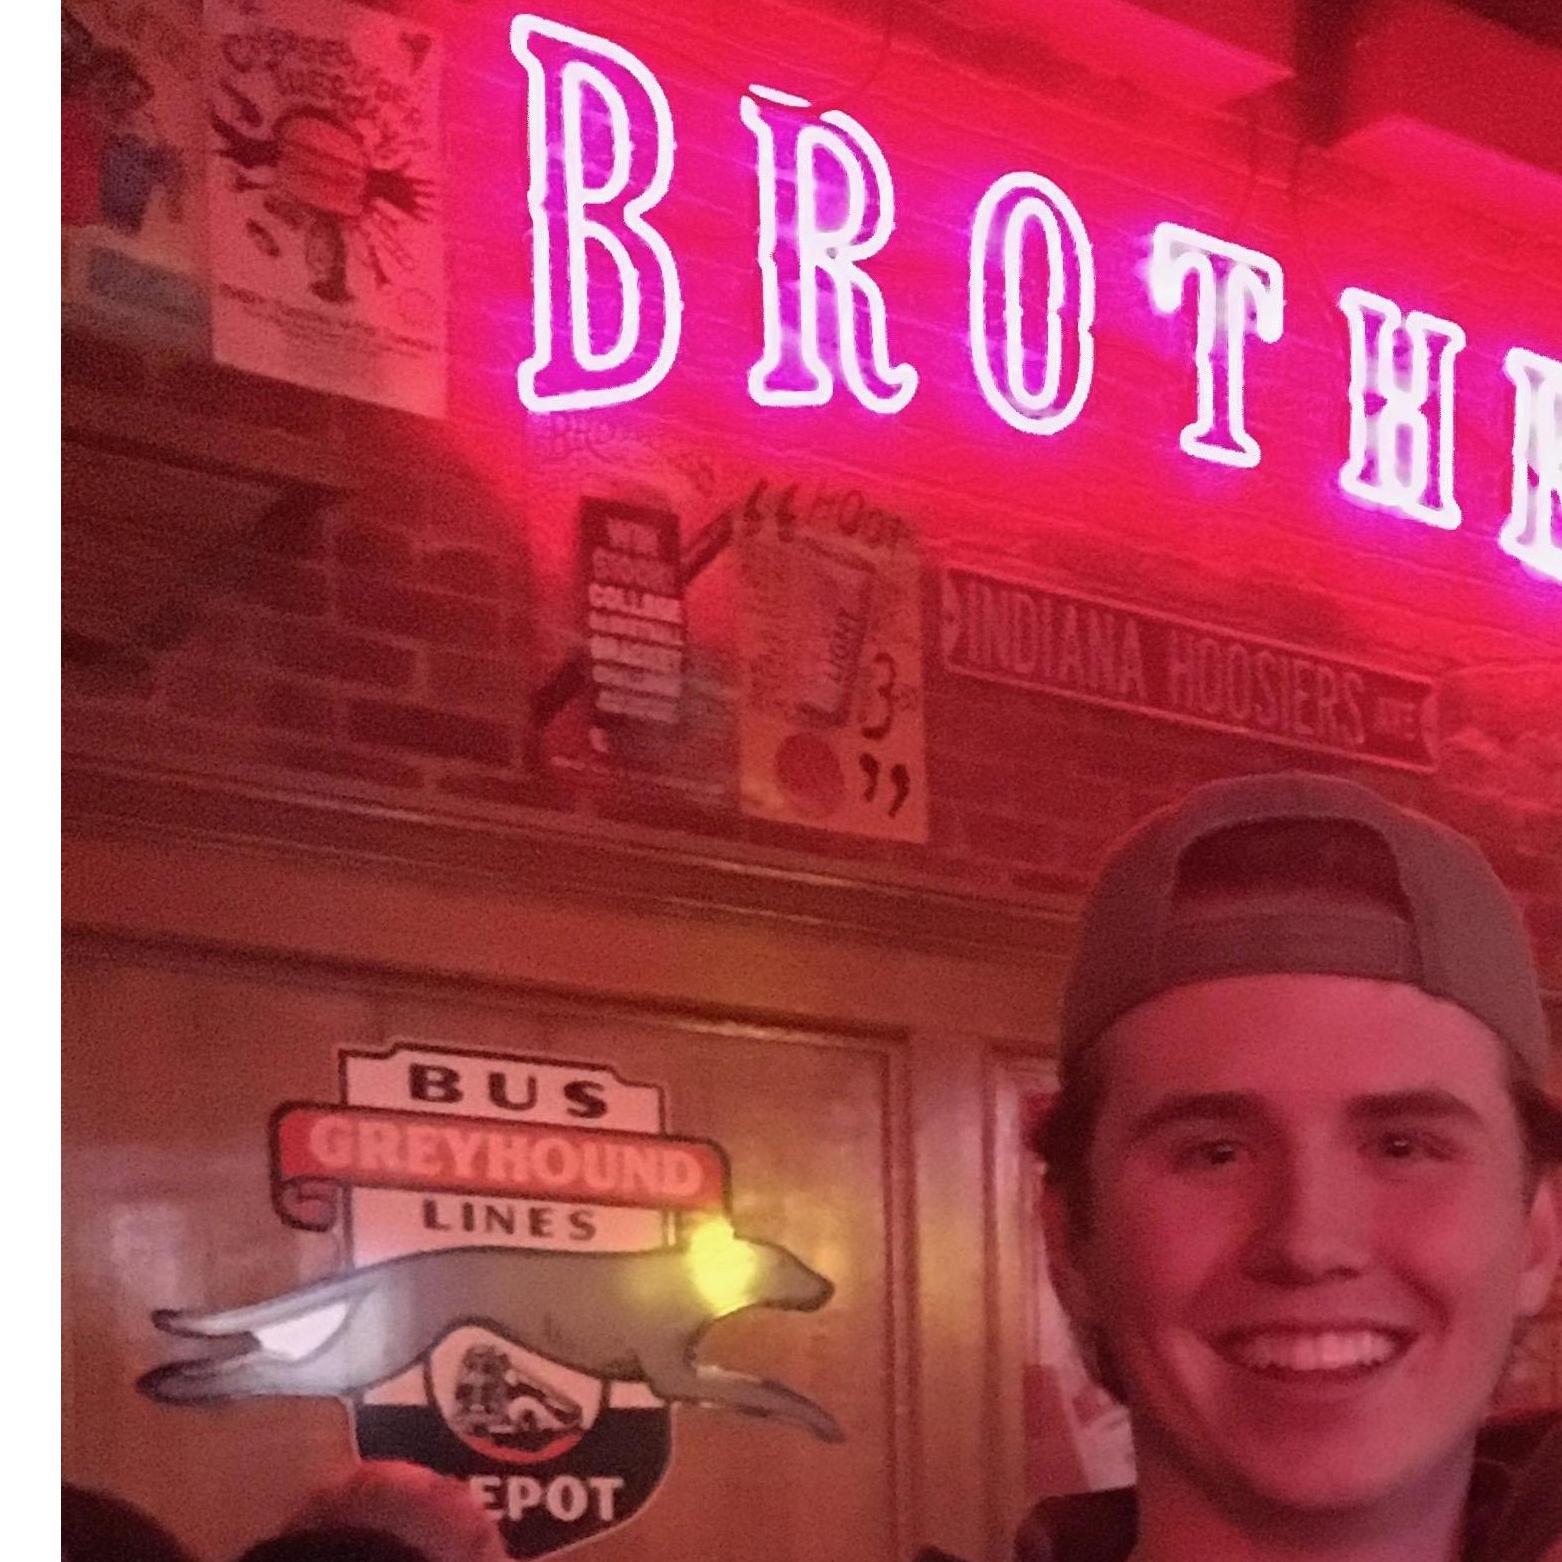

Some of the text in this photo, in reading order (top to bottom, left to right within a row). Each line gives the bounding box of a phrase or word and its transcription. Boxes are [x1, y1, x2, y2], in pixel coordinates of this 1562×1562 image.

[967, 579, 1146, 701] INDIANA
[1167, 630, 1366, 746] HOOSIERS
[408, 1063, 609, 1119] BUS
[308, 1114, 702, 1197] GREYHOUND
[422, 1198, 598, 1242] LINES
[469, 1474, 625, 1522] EPOT
